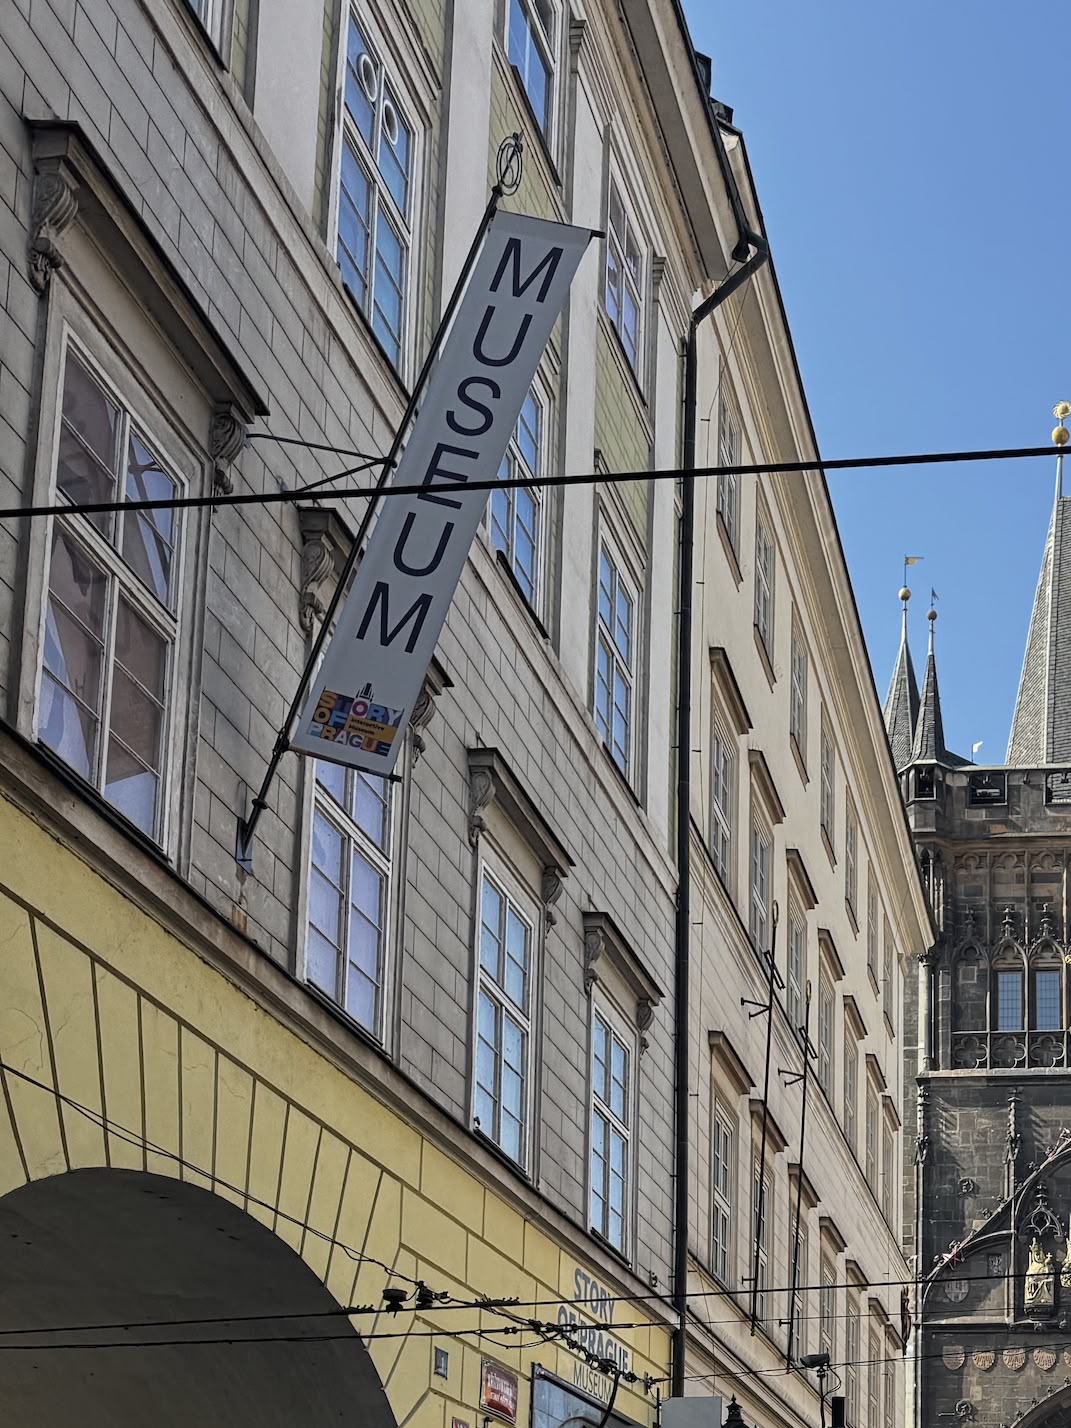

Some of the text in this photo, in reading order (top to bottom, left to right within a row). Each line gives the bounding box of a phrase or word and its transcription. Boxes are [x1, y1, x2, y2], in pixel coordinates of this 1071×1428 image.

[356, 238, 564, 654] MUSEUM
[313, 708, 349, 727] OF
[318, 691, 402, 726] STORY
[308, 722, 392, 757] PRAGUE
[574, 1267, 615, 1326] STORY
[573, 1359, 614, 1404] MUSEUM
